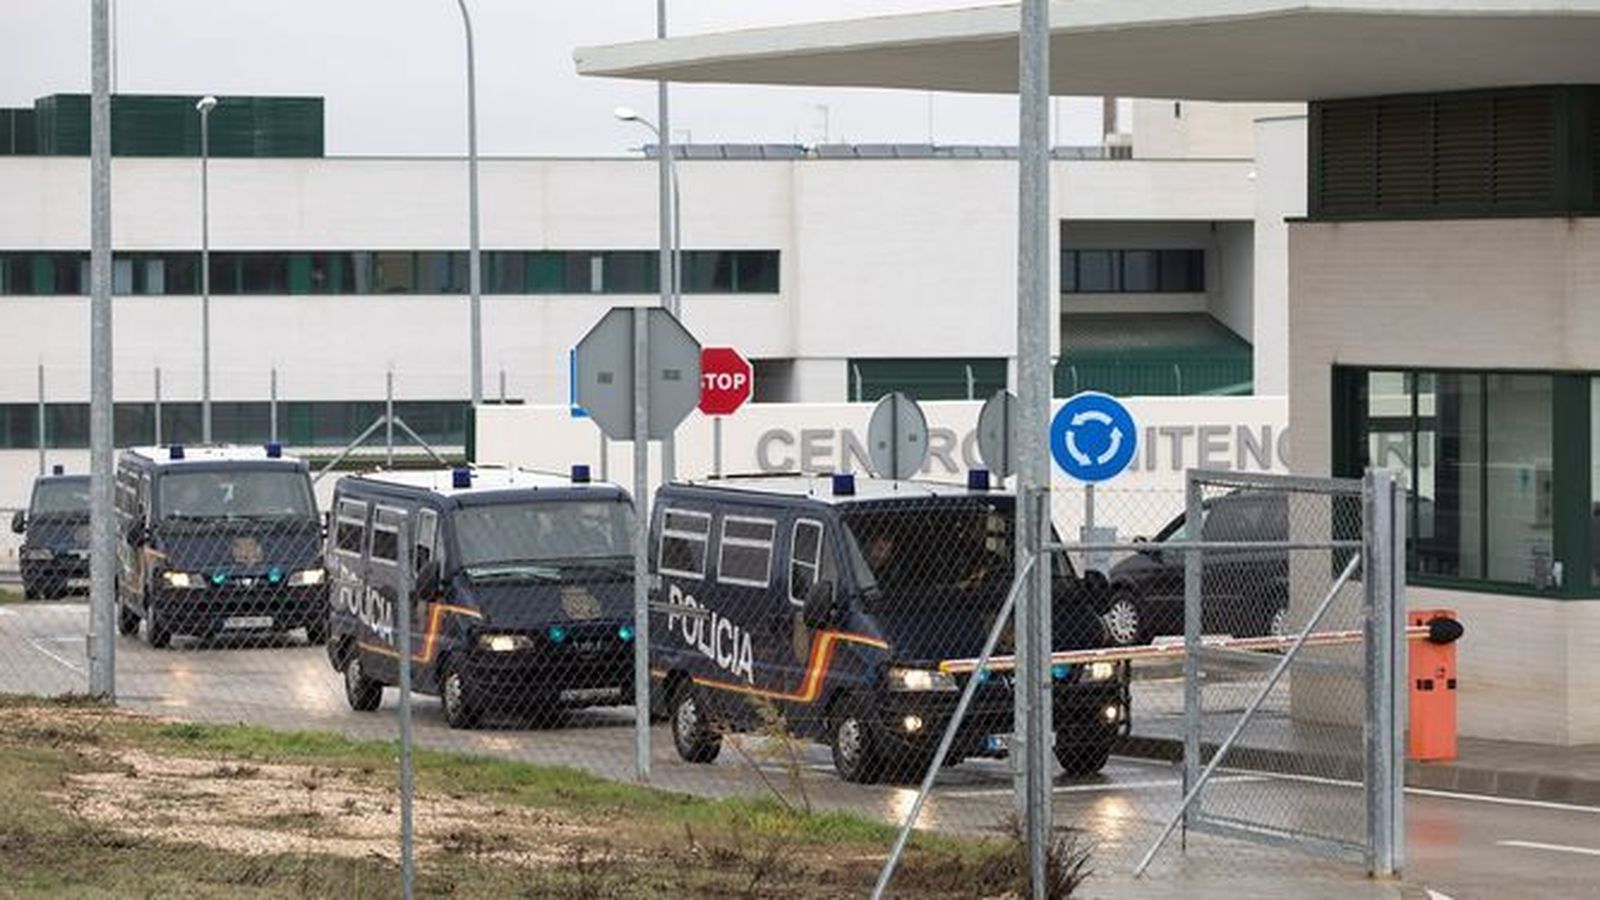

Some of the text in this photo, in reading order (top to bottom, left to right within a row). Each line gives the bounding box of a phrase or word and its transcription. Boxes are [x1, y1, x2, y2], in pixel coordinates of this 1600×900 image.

[700, 373, 747, 390] TOP
[755, 428, 980, 474] CENR
[668, 584, 754, 685] POLICIA
